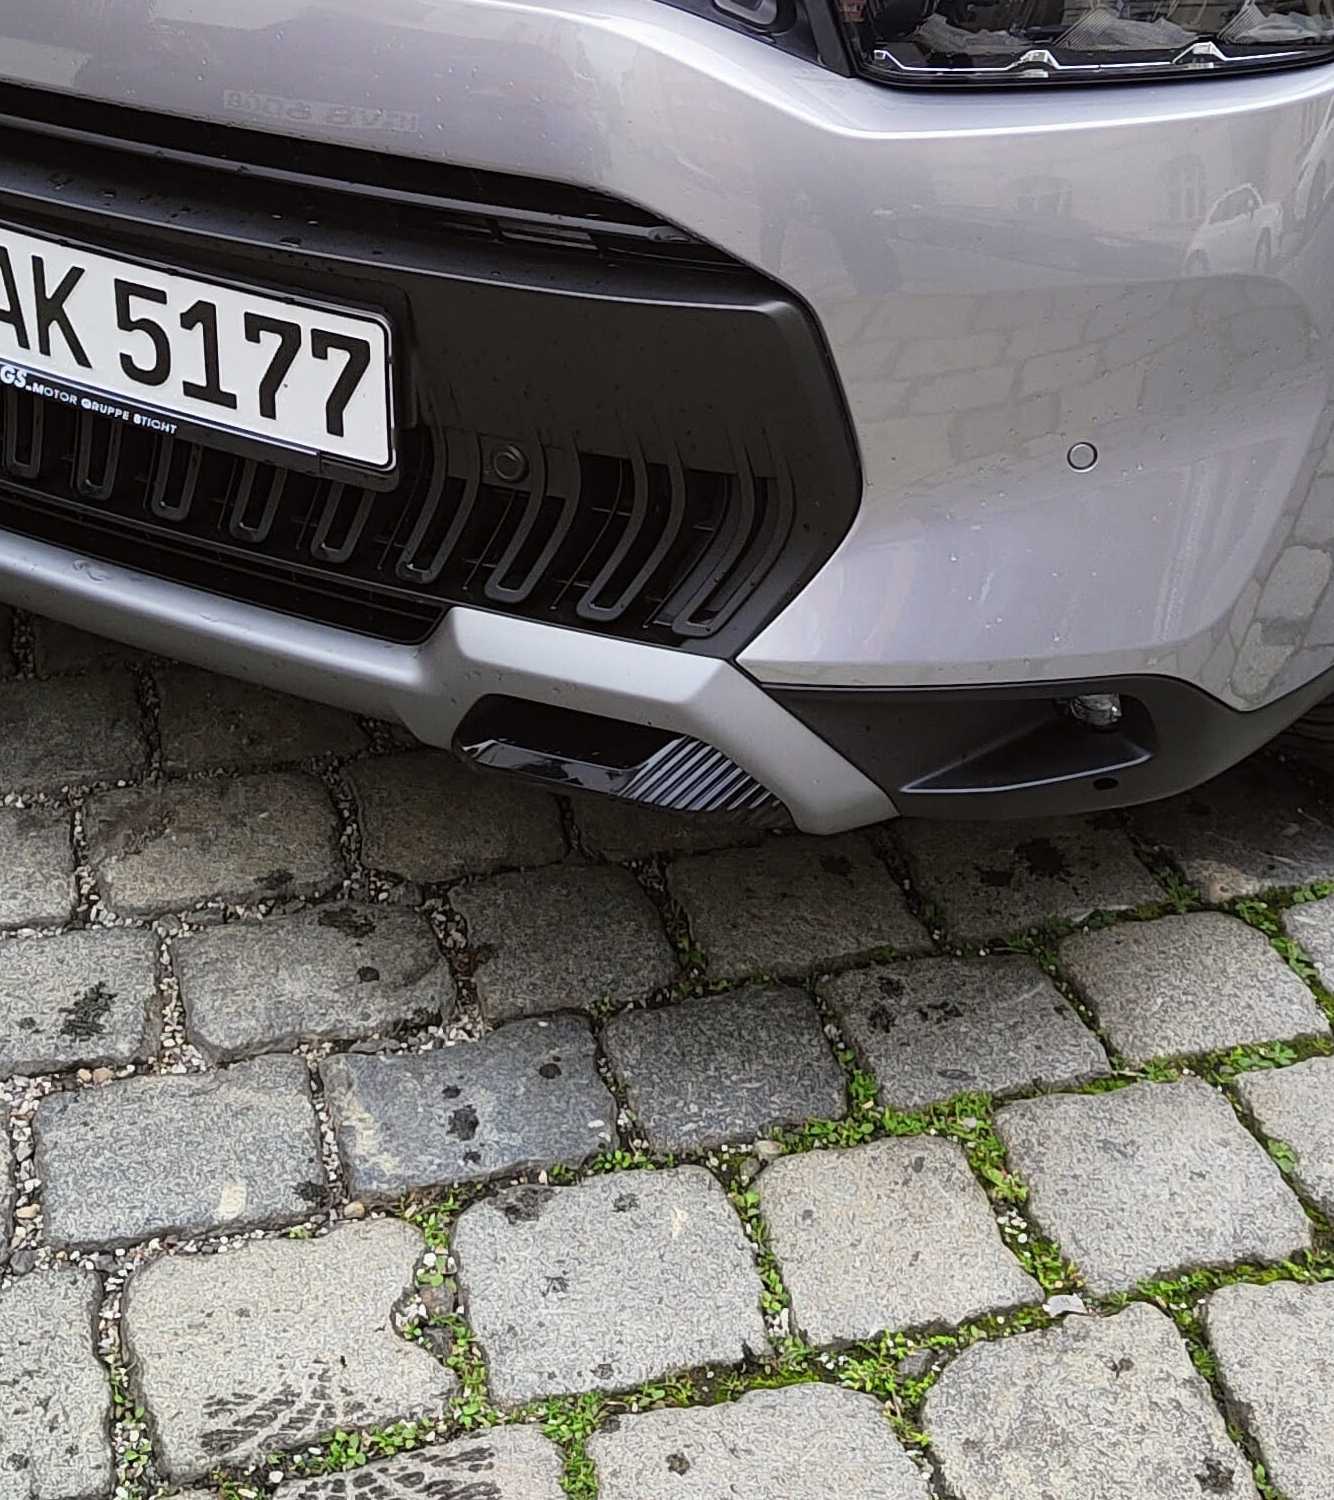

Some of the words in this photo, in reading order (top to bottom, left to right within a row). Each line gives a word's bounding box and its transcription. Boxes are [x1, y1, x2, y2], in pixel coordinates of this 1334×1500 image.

[32, 383, 78, 406] MOTOR
[81, 398, 130, 421] GRUPPE
[133, 413, 178, 435] STICHT
[113, 278, 371, 438] 5177
